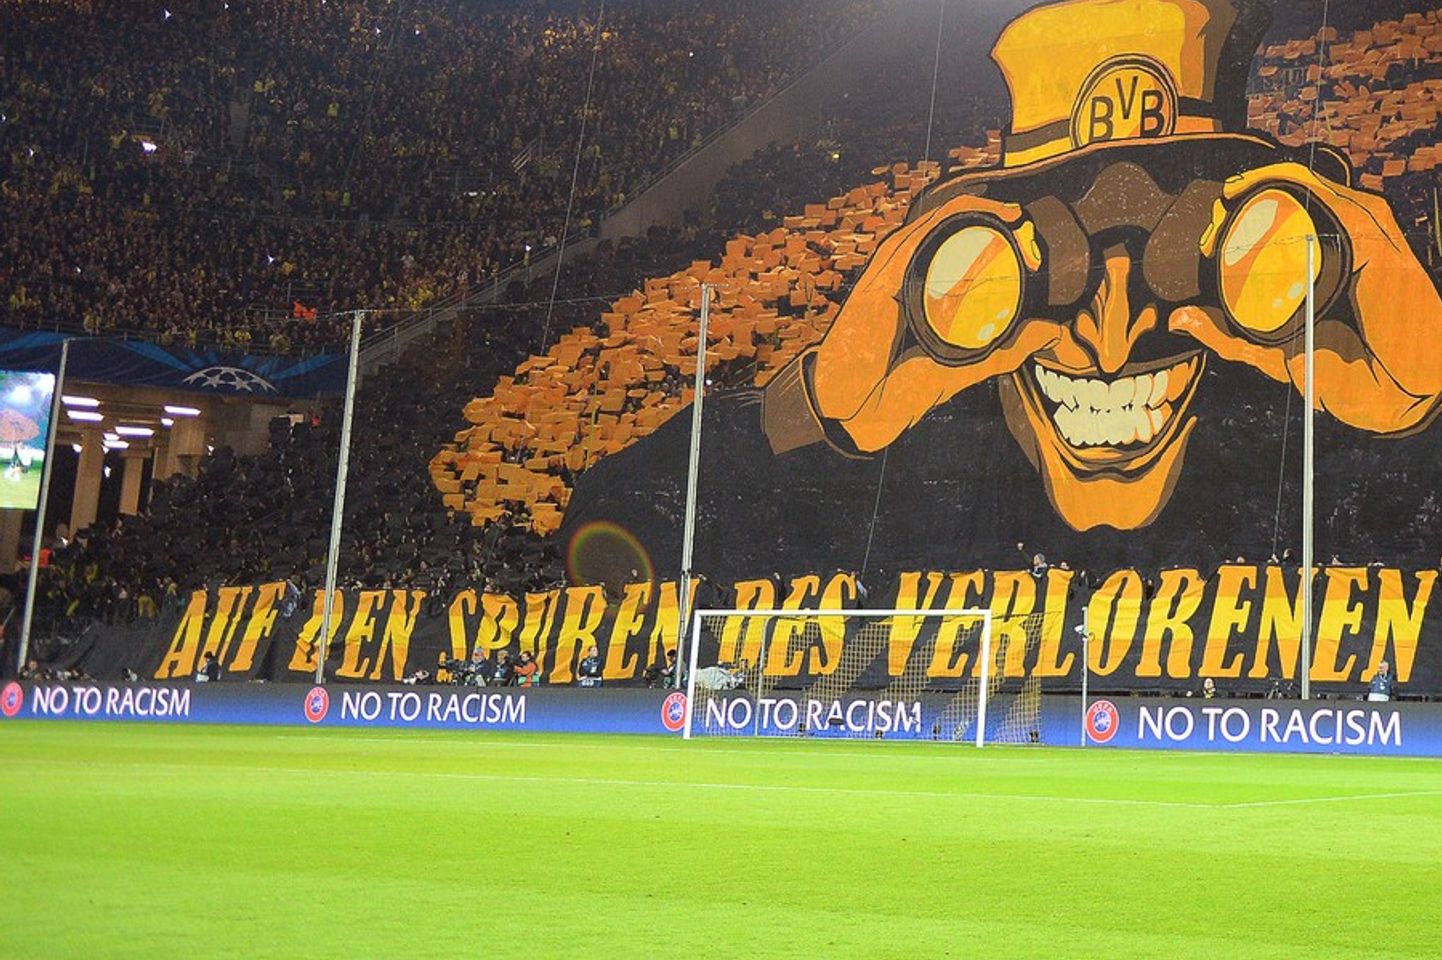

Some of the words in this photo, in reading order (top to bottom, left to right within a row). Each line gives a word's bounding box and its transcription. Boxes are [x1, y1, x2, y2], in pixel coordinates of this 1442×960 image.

[1090, 76, 1165, 141] BVB
[153, 581, 287, 680] AUF
[288, 589, 427, 681] DEN
[436, 578, 700, 684] SPUREN
[717, 572, 858, 677] DES
[887, 564, 1438, 683] VERLORENEN
[32, 685, 69, 716] NO
[73, 687, 101, 715] TO
[106, 687, 190, 717] RACISM
[341, 691, 382, 721] NO
[387, 692, 421, 721] TO
[427, 693, 526, 724] RACISM
[705, 697, 752, 729] NO
[759, 698, 798, 730] TO
[806, 699, 922, 734] RACISM
[1138, 705, 1194, 741] NO
[1202, 707, 1250, 743] TO
[1260, 707, 1402, 746] RACISM
